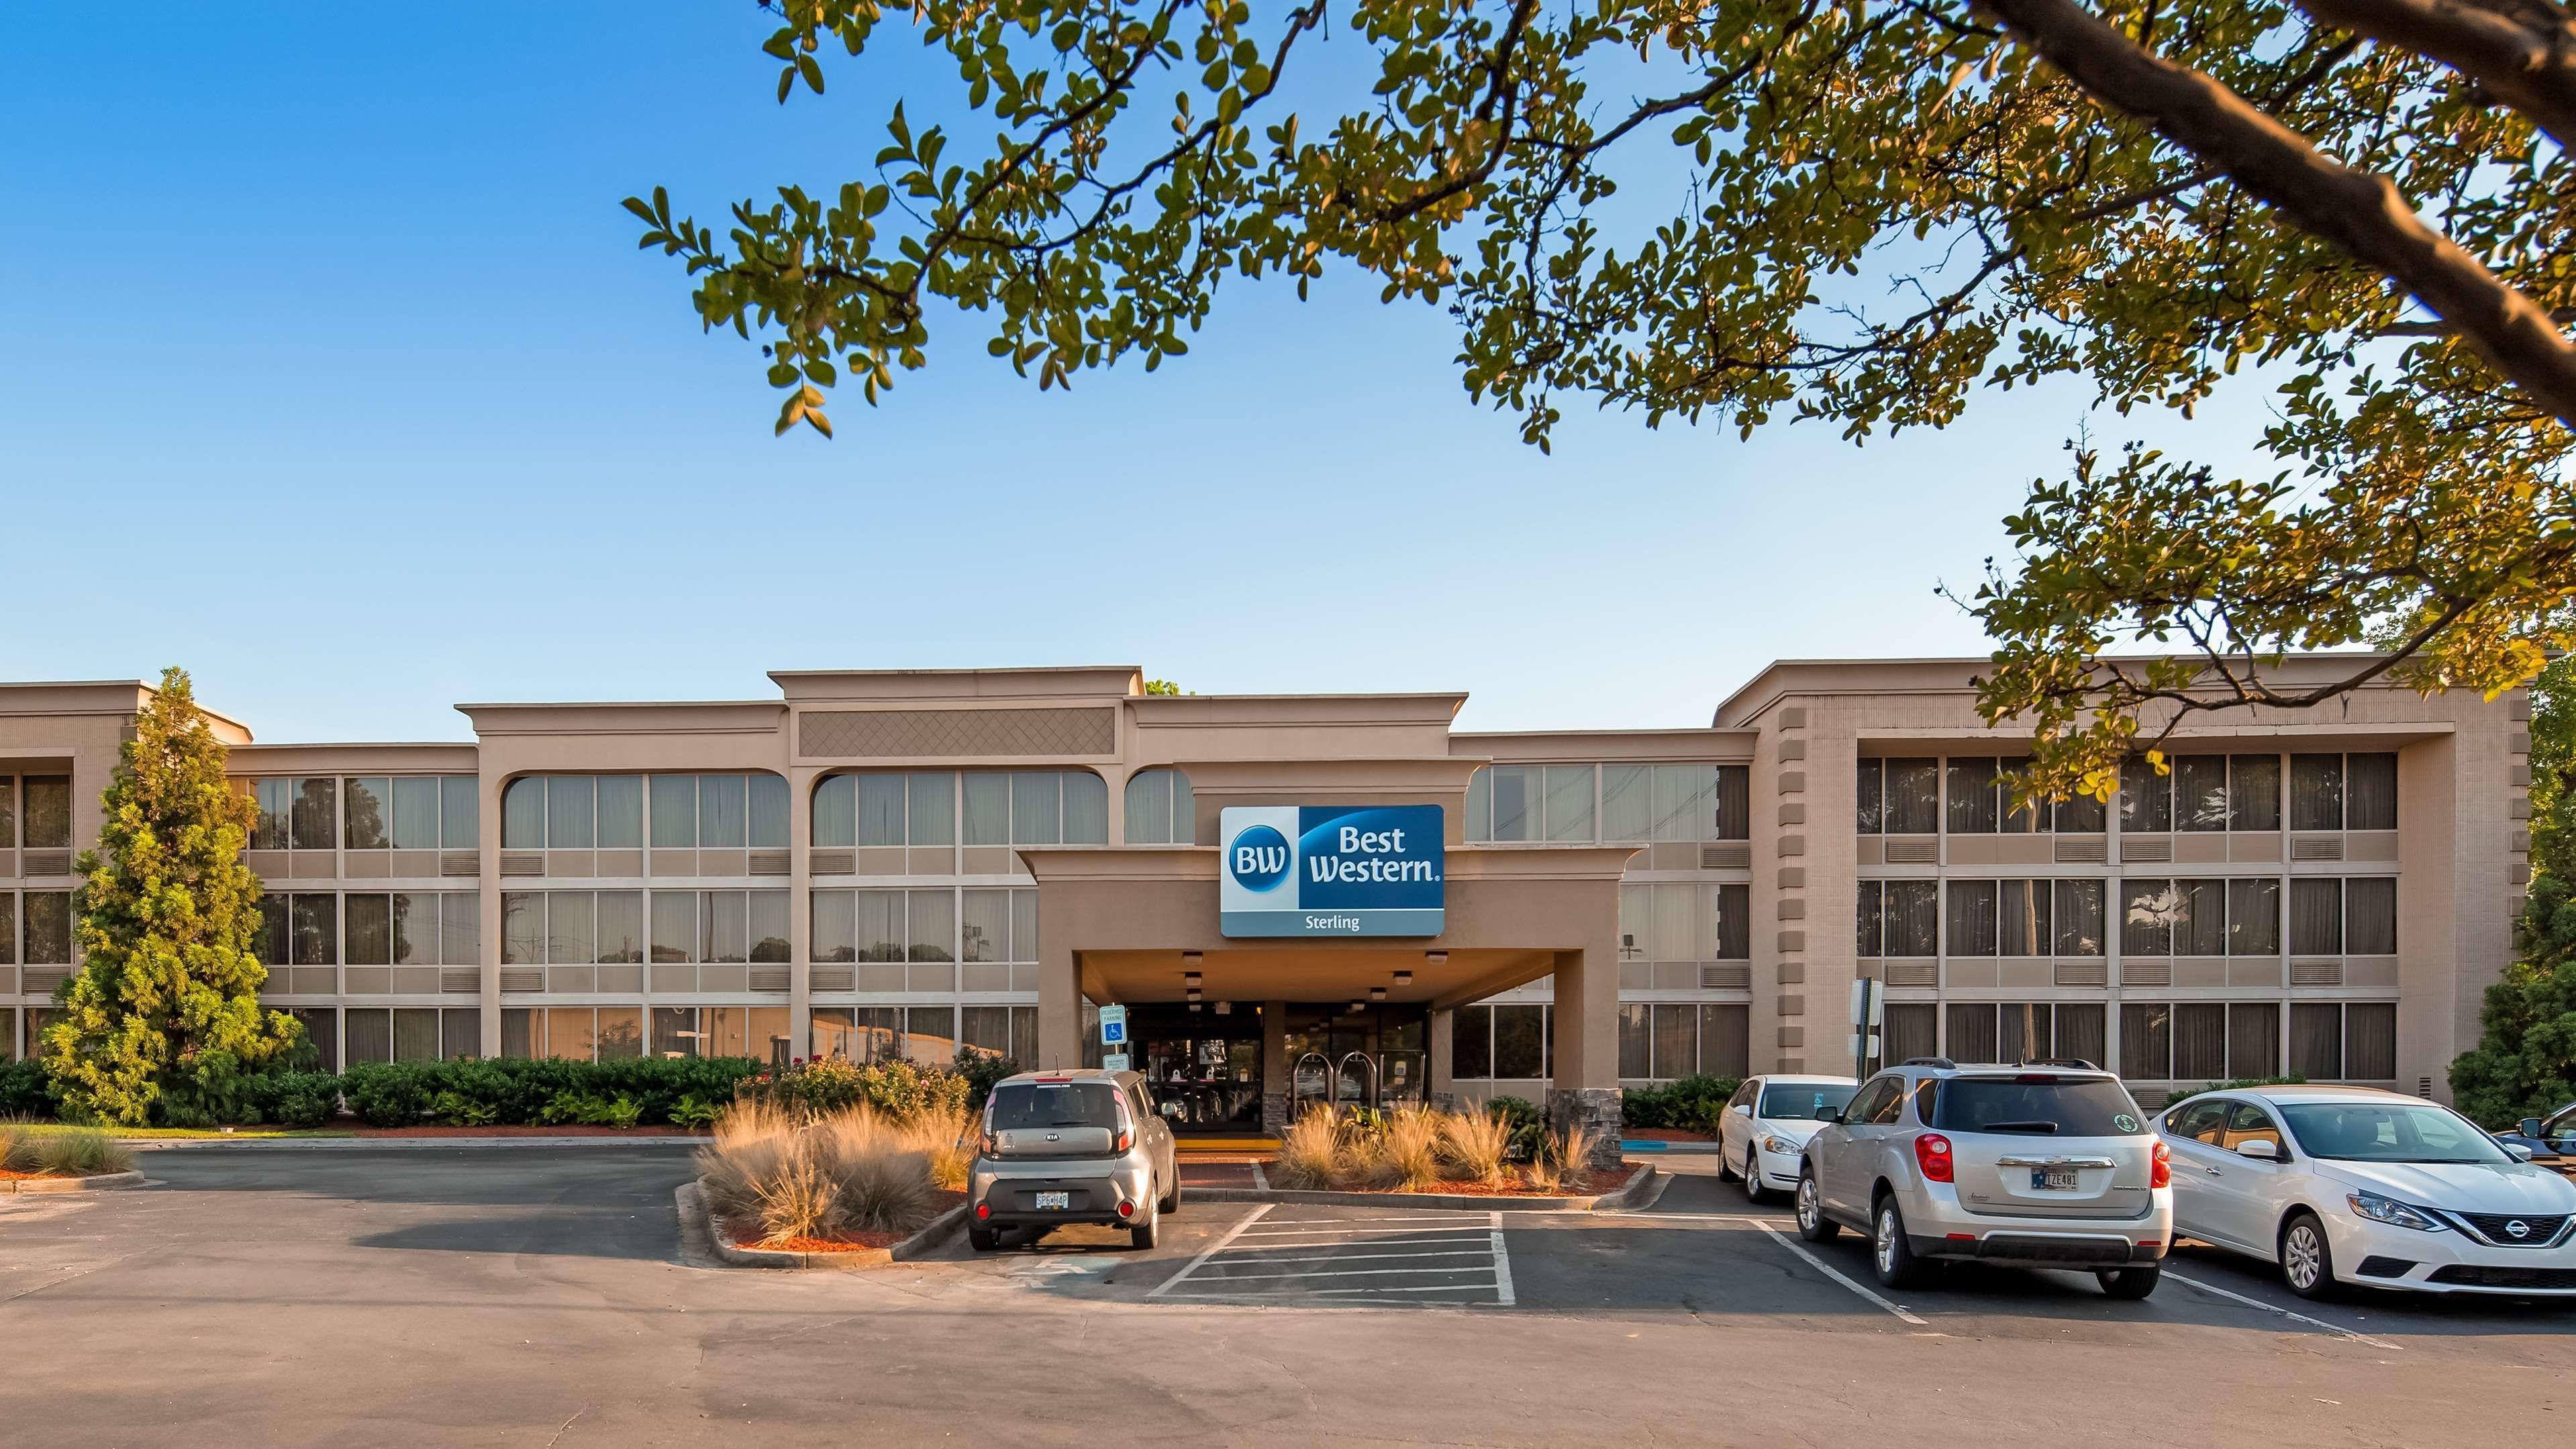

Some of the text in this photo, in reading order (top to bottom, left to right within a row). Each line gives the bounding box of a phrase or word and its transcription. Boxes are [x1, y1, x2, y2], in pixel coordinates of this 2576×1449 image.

[1339, 826, 1406, 854] Best
[1236, 846, 1286, 874] BW
[1305, 915, 1360, 932] Sterling
[2046, 1174, 2077, 1185] TZE481
